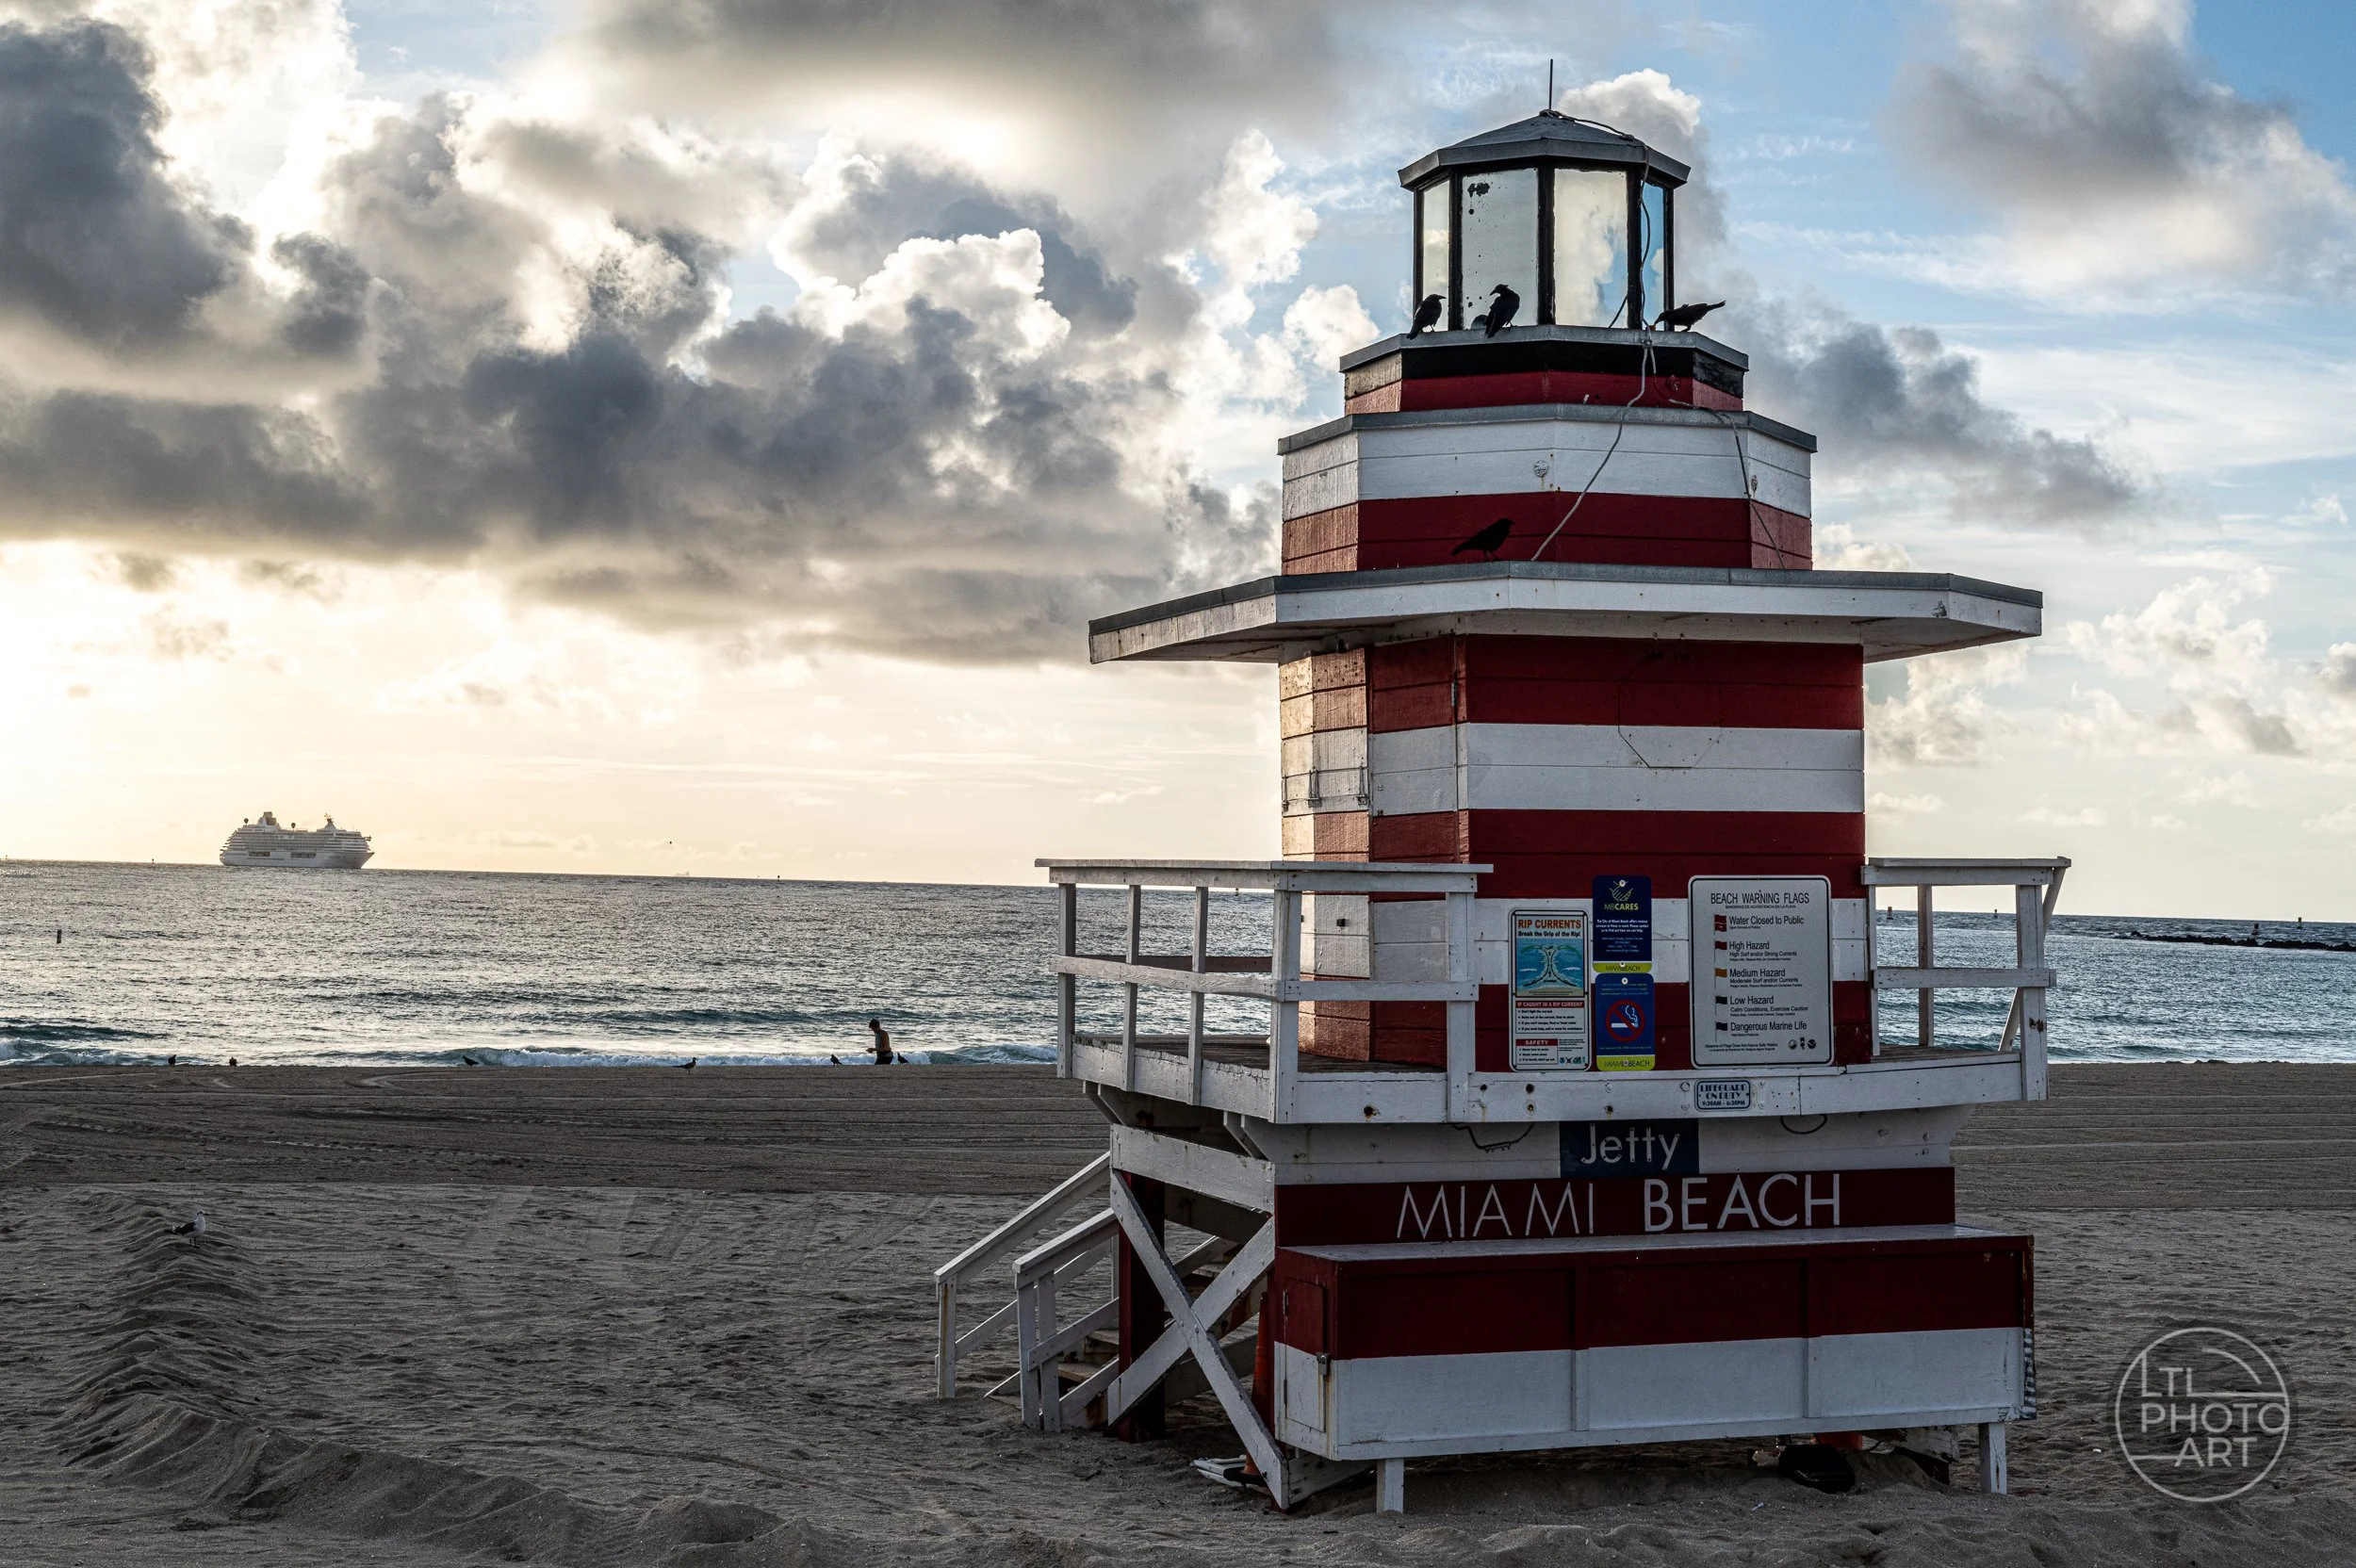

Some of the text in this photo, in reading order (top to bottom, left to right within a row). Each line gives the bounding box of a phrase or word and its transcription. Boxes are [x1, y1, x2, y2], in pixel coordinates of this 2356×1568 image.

[1710, 892, 1809, 904] BEACH WARNING FLAGS
[1518, 920, 1581, 928] RIP CURRENTS
[1729, 915, 1804, 924] Water Closed to Public
[1729, 940, 1770, 952] High Hazard
[1729, 968, 1786, 977] Medium Hazard
[1730, 995, 1774, 1004] Low Hazard
[1730, 1021, 1807, 1033] Dangerous Marine Life
[1580, 1122, 1680, 1170] Jetty
[1397, 1173, 1841, 1239] MIAMI BEACH
